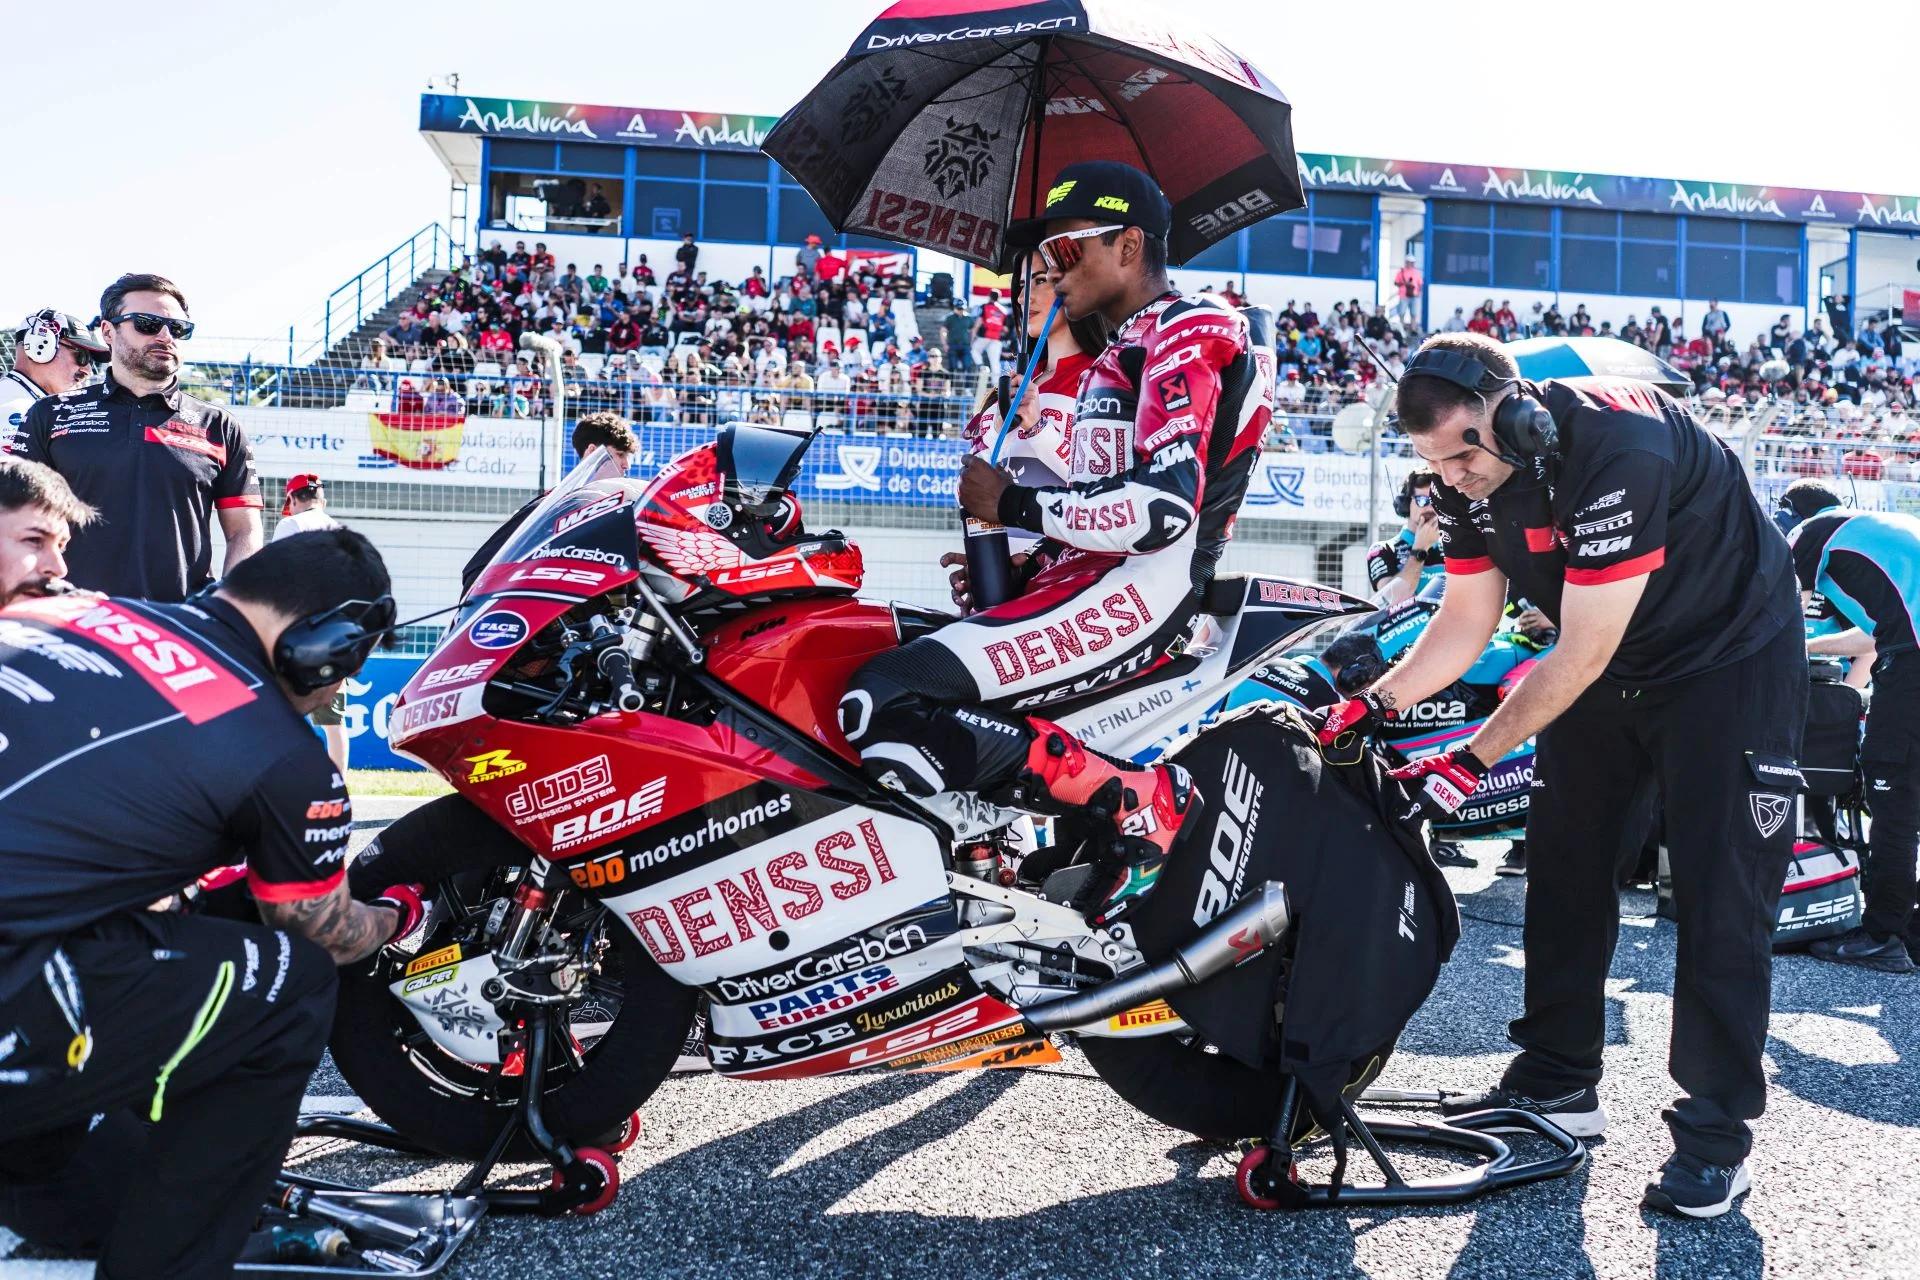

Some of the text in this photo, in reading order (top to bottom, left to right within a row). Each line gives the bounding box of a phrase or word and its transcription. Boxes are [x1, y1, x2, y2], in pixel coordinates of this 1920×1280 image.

[458, 98, 597, 139] Andalucía
[1094, 195, 1130, 213] KTM
[1482, 166, 1603, 205] Andalucía
[1670, 180, 1787, 218] Andalucía
[888, 475, 912, 494] de
[1578, 535, 1633, 557] KTM
[716, 560, 795, 586] LS2
[983, 583, 1154, 686] DENSSI
[1096, 688, 1174, 735] FINLAND
[629, 792, 793, 874] motorhomes
[1120, 804, 1158, 837] 21
[627, 817, 898, 965] DENSSI
[1778, 893, 1856, 924] LS2
[717, 923, 928, 1002] DriverCarsbcn
[748, 963, 893, 1022] PARTS
[758, 974, 900, 1032] EUROPE
[855, 979, 962, 1033] Luxurious
[709, 1020, 856, 1066] FACE
[849, 1006, 981, 1065] LS2
